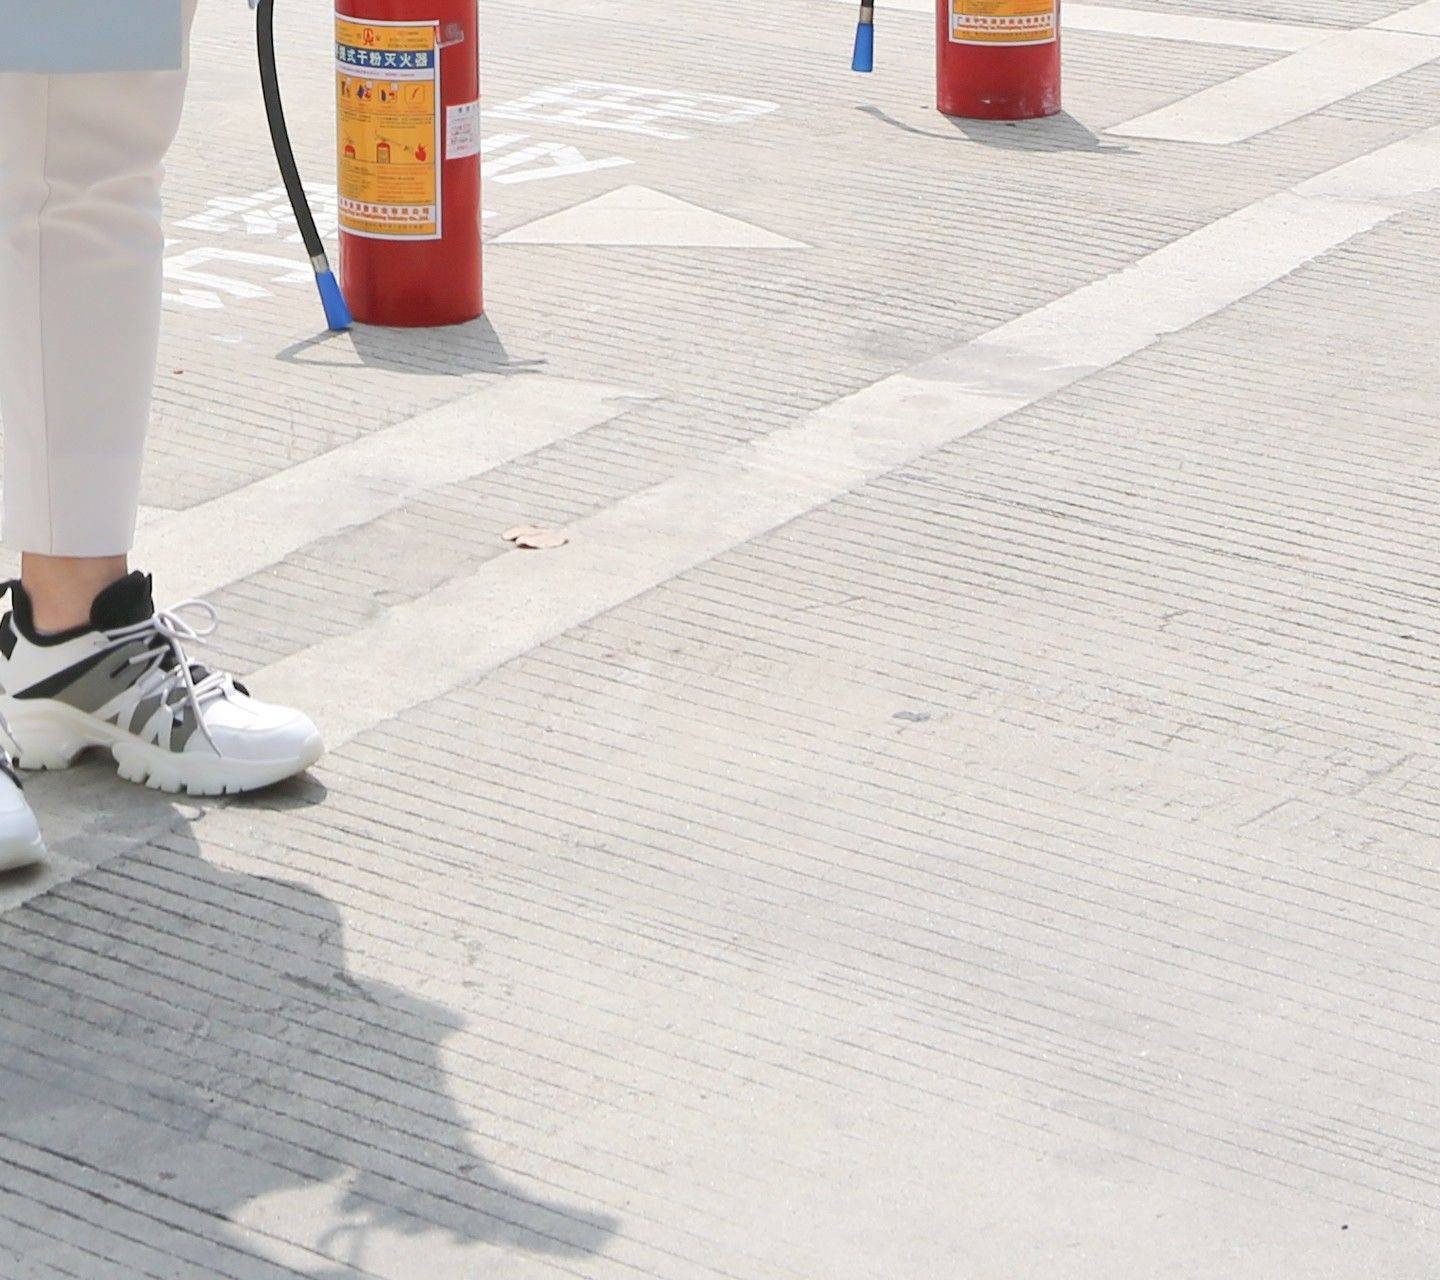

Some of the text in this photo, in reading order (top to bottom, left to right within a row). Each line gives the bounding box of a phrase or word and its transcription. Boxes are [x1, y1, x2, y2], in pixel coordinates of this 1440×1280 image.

[336, 47, 429, 68] 提式干粉灭火器
